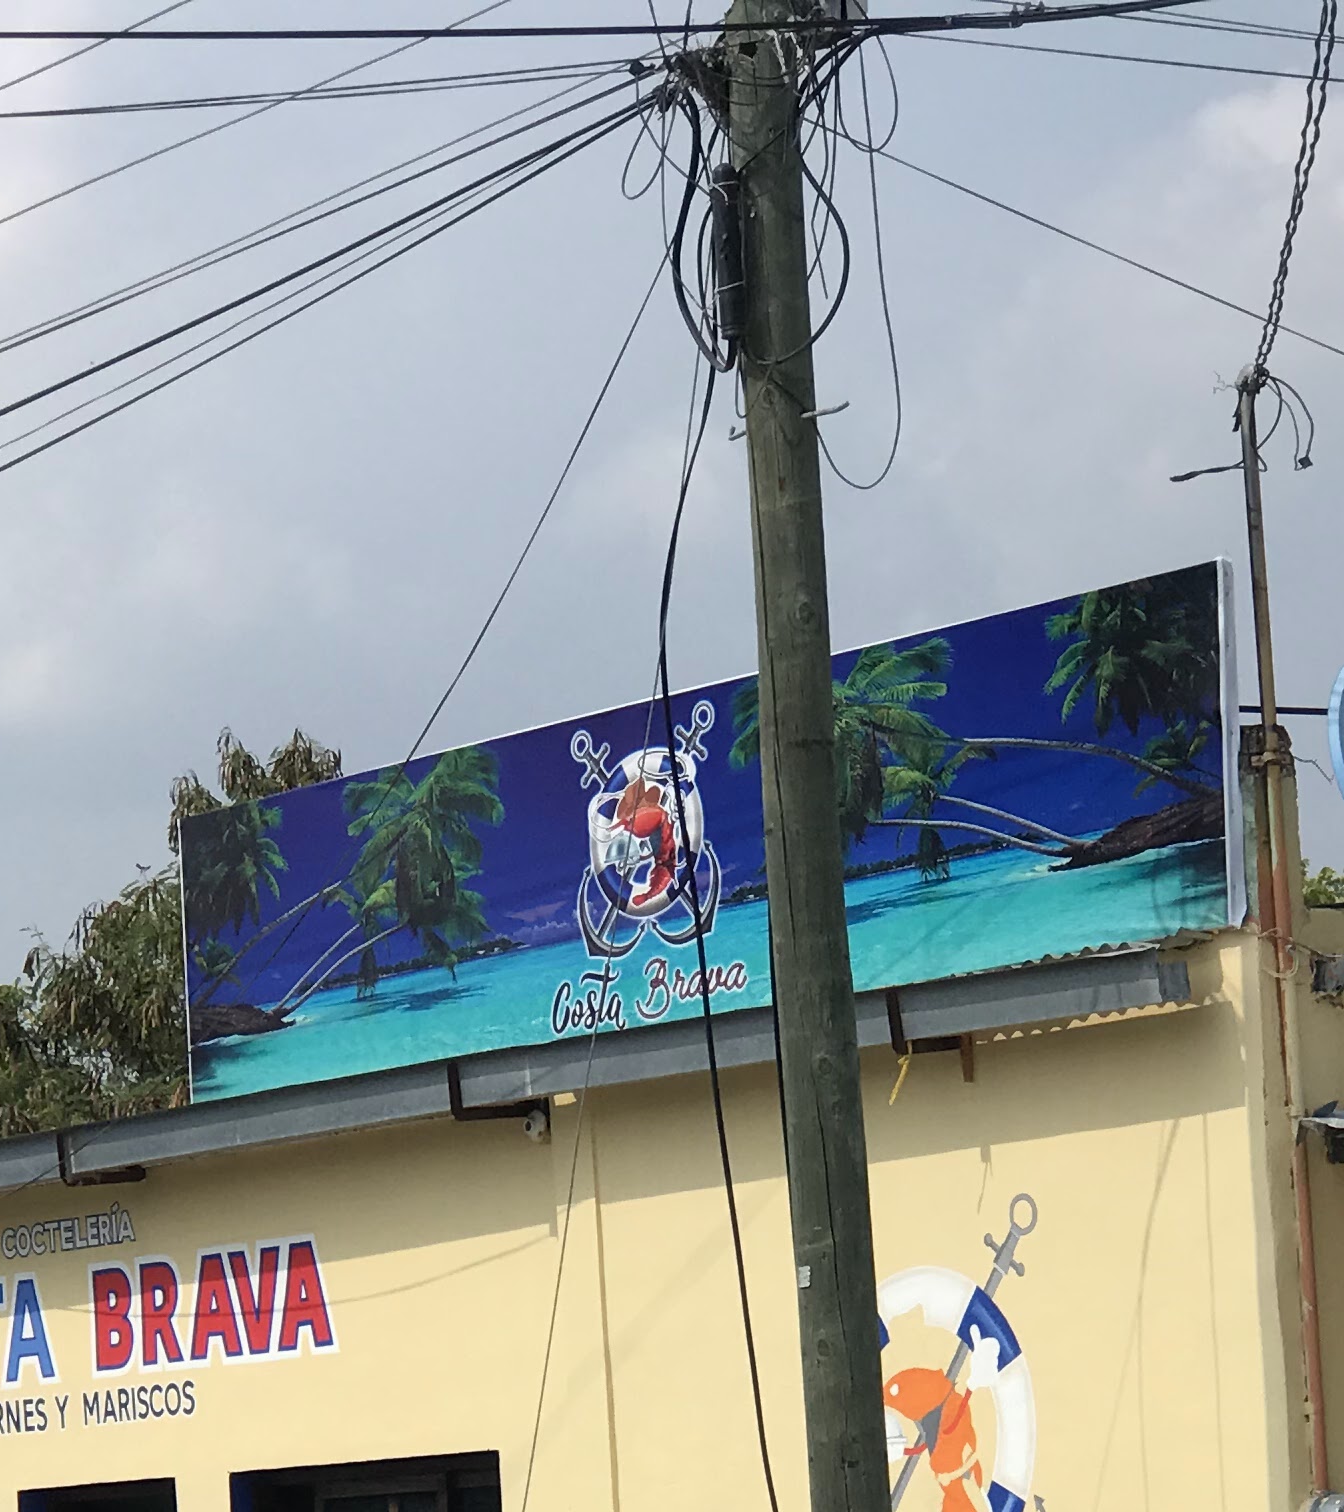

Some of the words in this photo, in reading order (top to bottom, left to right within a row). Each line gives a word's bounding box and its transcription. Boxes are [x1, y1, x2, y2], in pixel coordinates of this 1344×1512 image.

[552, 962, 627, 1036] Costa
[636, 957, 748, 1019] Brava
[1, 1201, 136, 1259] COCTELERÍA
[89, 1236, 337, 1375] BRAVA
[54, 1394, 69, 1429] Y
[83, 1380, 196, 1425] MARISCOS
